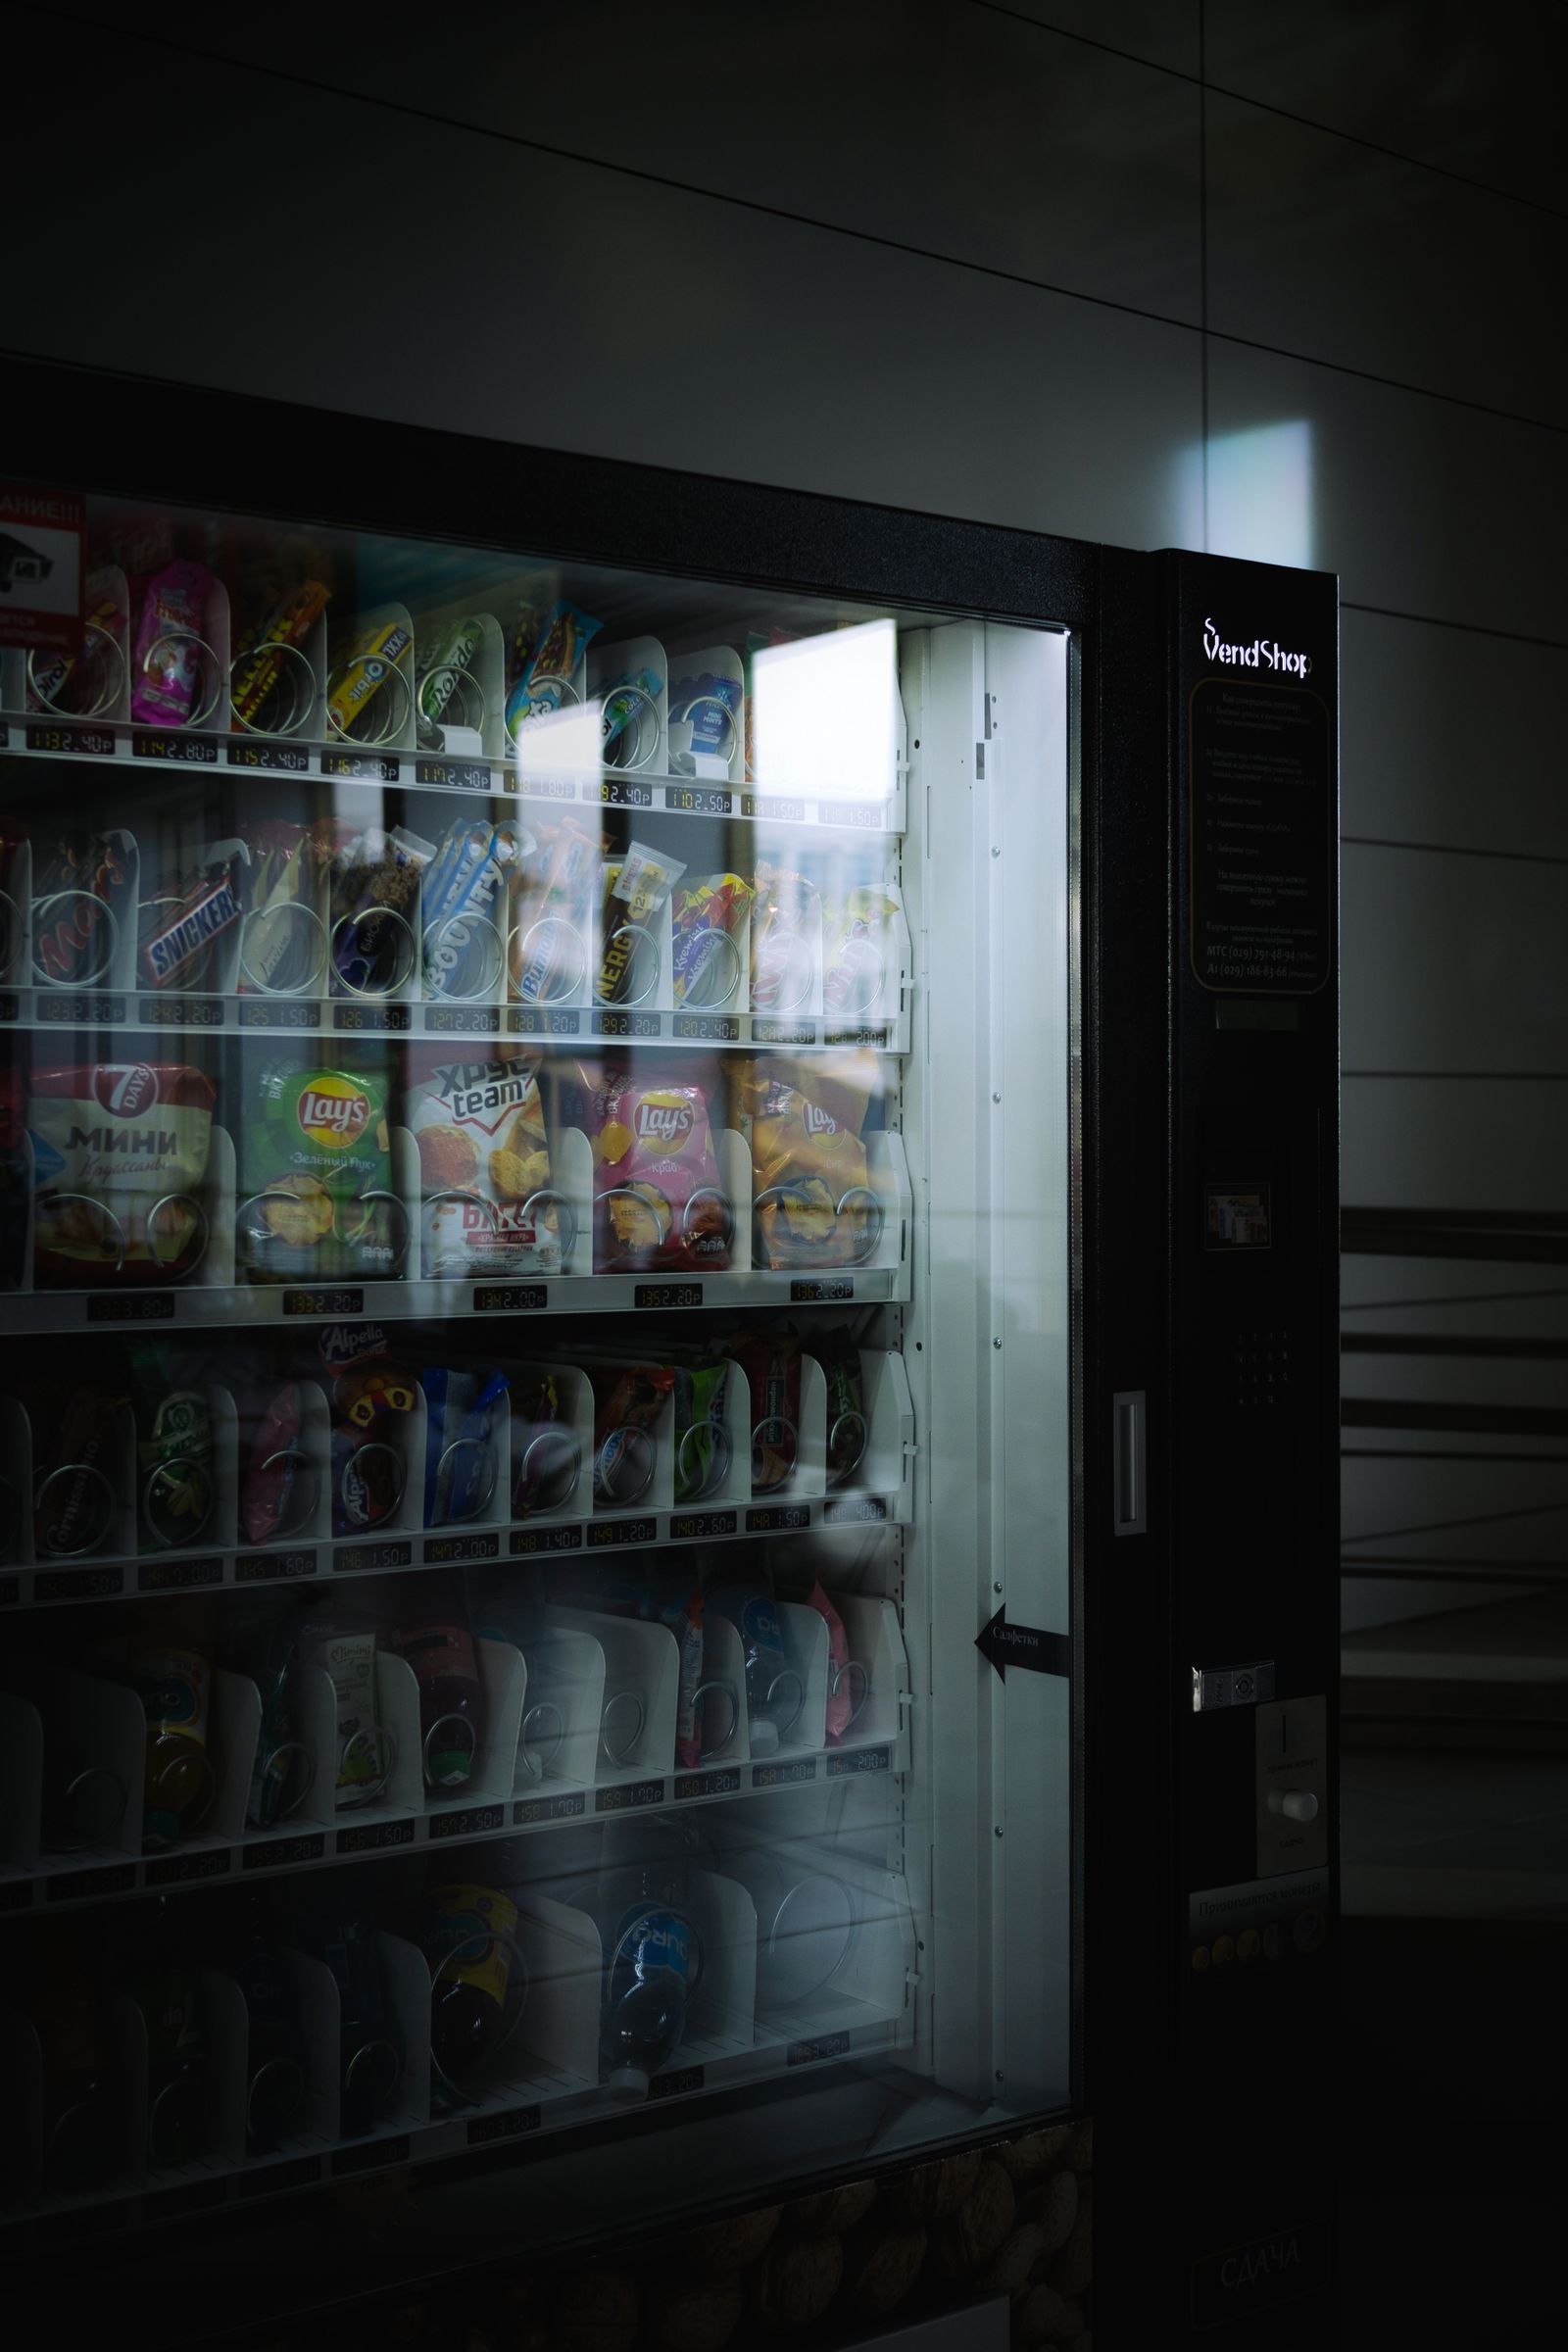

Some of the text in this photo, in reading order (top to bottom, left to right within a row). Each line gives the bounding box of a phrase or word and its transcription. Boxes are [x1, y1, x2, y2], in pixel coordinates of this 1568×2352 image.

[1203, 631, 1313, 679] VendShop
[302, 1093, 368, 1131] Lay's
[453, 1081, 524, 1118] team
[808, 1102, 837, 1135] Lay
[65, 1126, 177, 1156] МИНИ
